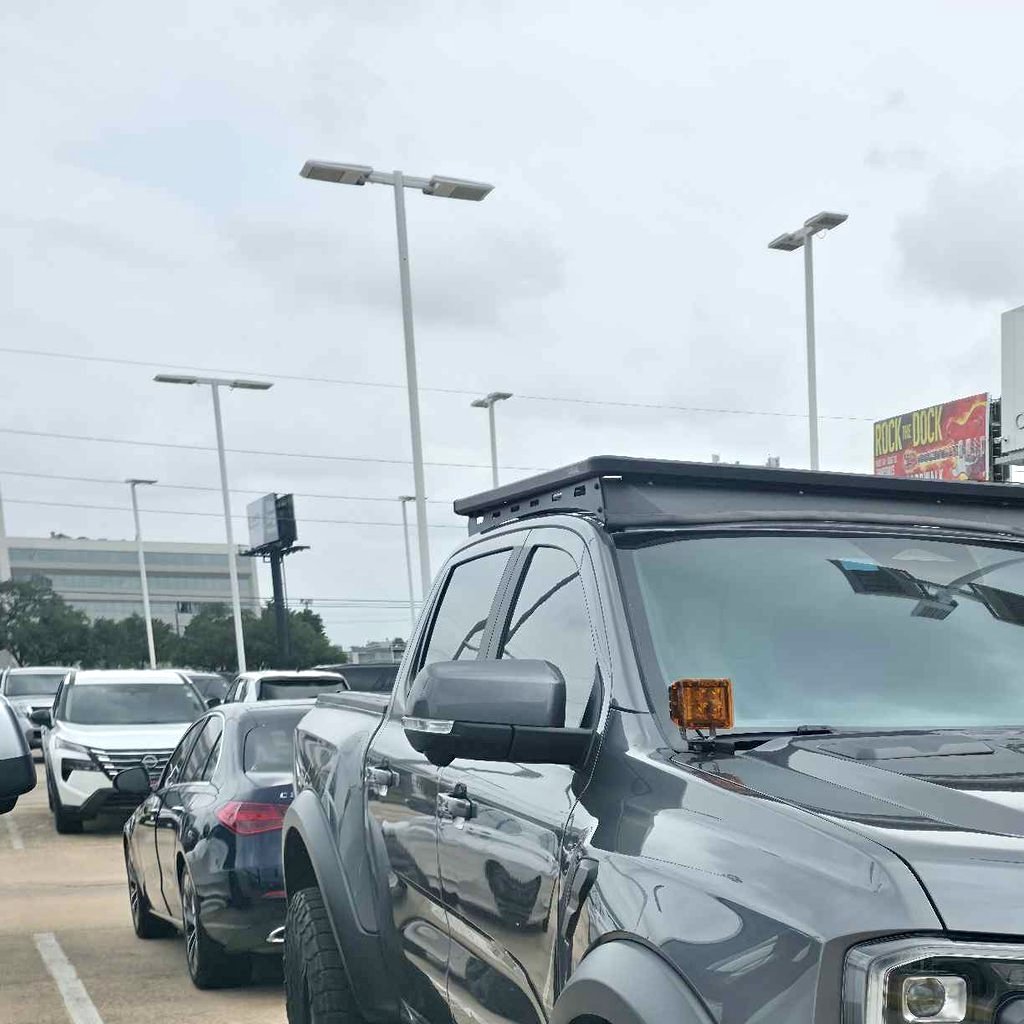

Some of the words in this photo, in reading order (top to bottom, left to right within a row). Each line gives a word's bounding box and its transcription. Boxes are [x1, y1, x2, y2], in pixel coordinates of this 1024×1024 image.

[875, 417, 902, 456] ROCK
[902, 423, 912, 440] THE
[912, 405, 943, 447] DOCK
